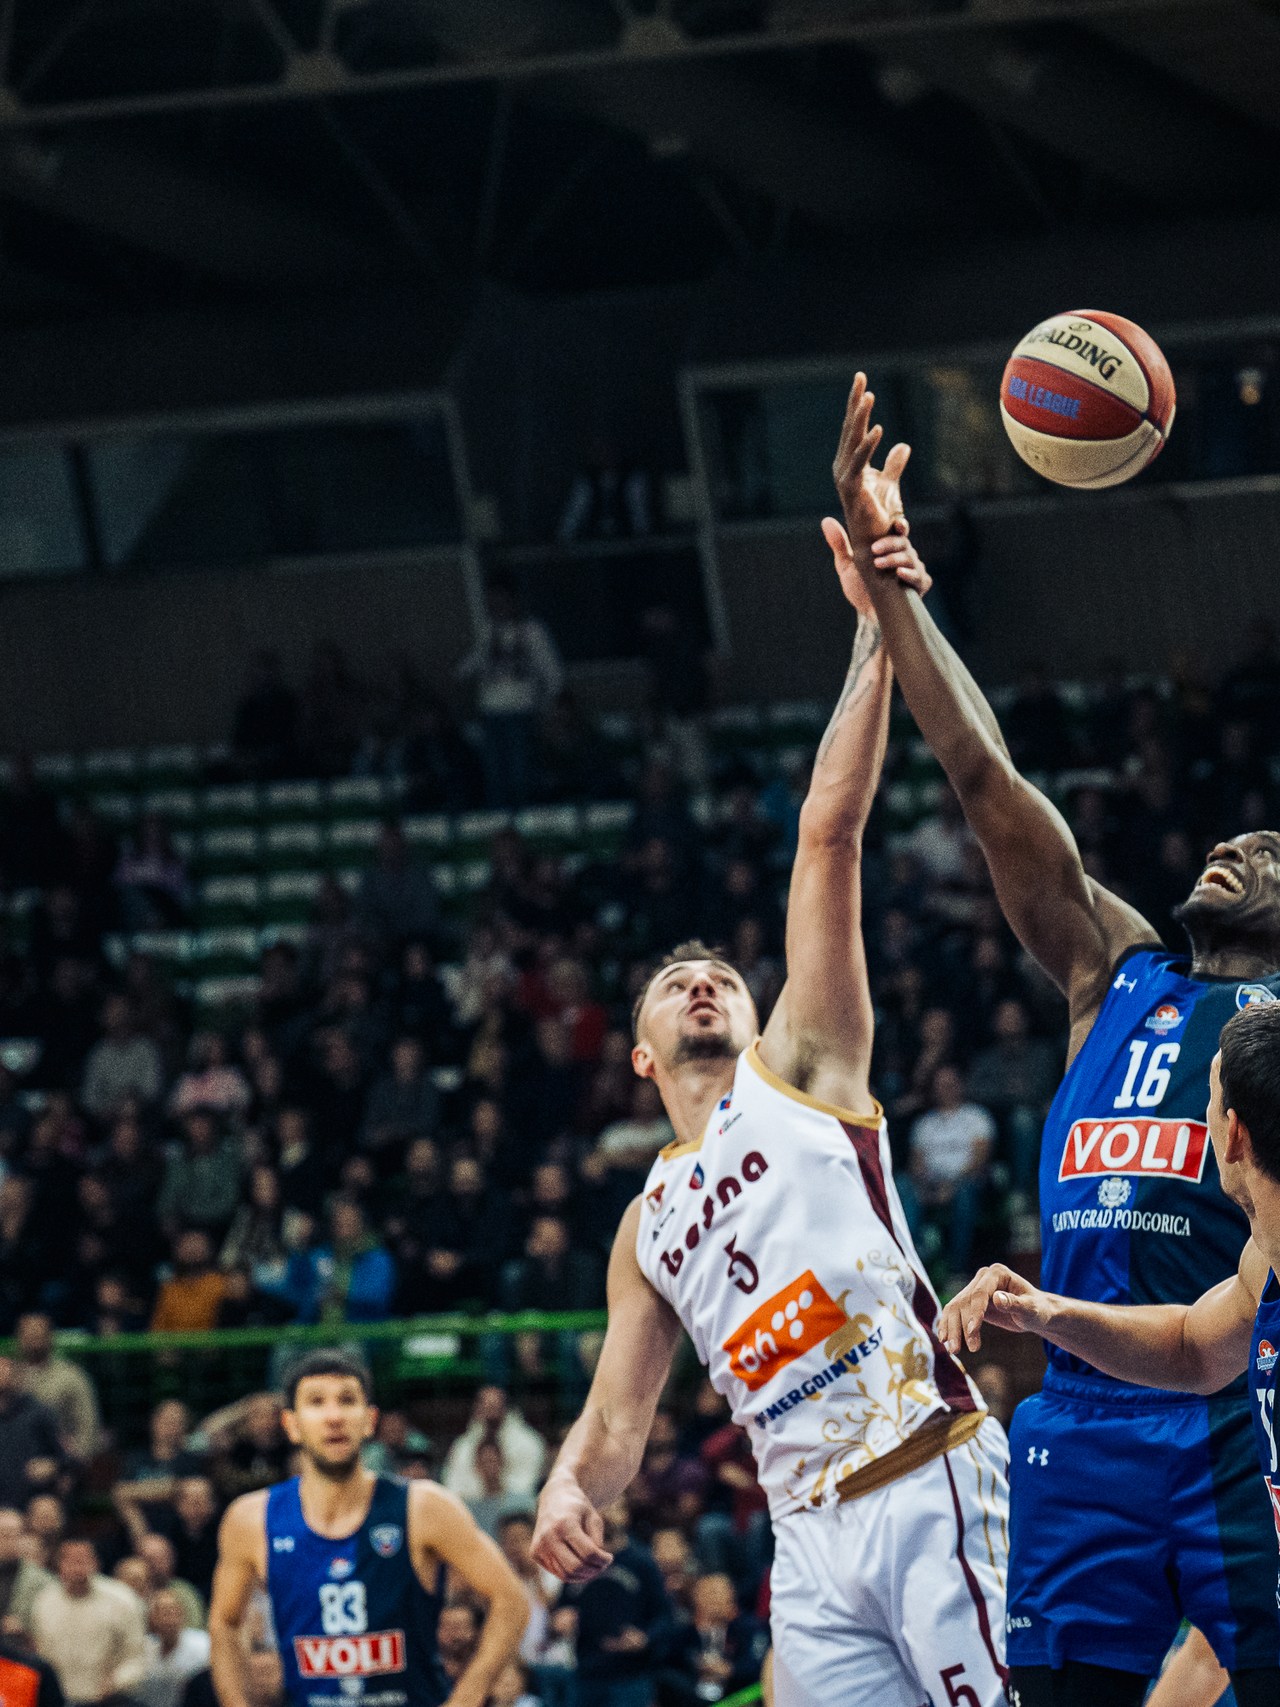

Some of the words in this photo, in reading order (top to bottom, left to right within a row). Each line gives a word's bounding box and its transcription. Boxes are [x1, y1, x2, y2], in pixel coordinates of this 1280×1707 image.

[1028, 384, 1081, 420] LEAGUE
[1113, 1039, 1181, 1109] 16
[1073, 1122, 1191, 1171] VOLI
[1080, 1209, 1113, 1229] GRAD
[1113, 1208, 1191, 1237] PODGORICA
[723, 1232, 759, 1294] 5
[318, 1580, 369, 1635] 83
[303, 1636, 392, 1673] VOLI
[940, 1663, 982, 1707] 5
